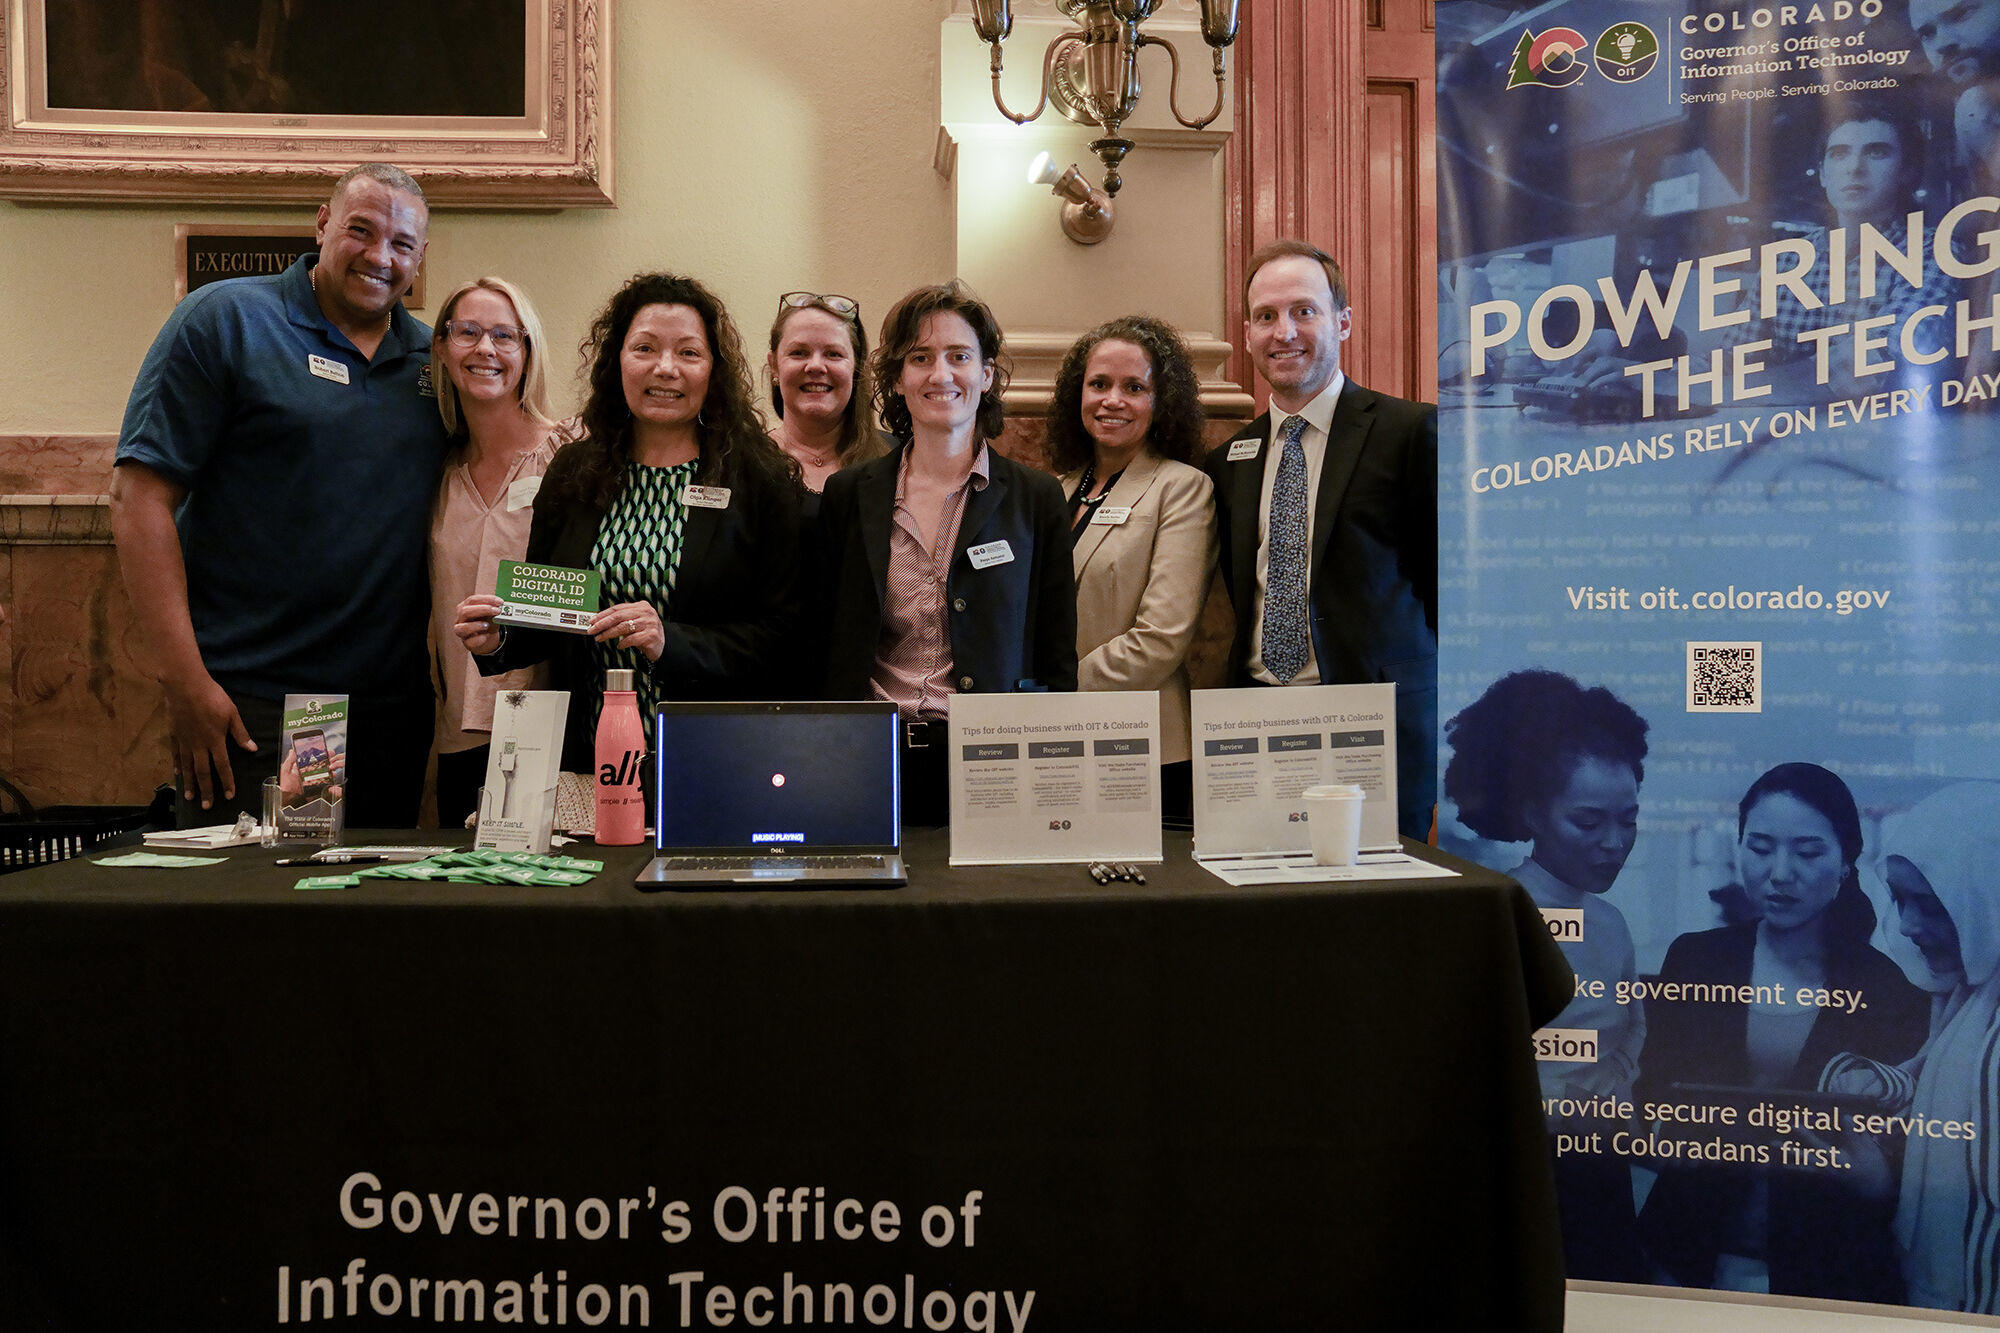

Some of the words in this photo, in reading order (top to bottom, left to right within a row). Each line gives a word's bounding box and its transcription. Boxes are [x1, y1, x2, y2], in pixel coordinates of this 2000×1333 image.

[1680, 0, 1883, 34] COLORADO
[1680, 41, 1779, 61] Governor's
[1784, 34, 1841, 53] Office
[1845, 31, 1865, 46] of
[1617, 67, 1636, 77] OIT
[1680, 59, 1792, 79] Information
[1796, 49, 1910, 70] Technology
[1680, 91, 1727, 104] Serving
[1731, 87, 1777, 101] People.
[1781, 83, 1830, 97] Serving
[1834, 76, 1899, 92] Colorado.
[195, 252, 297, 272] EXECUTIVE
[1470, 196, 2000, 377] POWERING
[1624, 340, 1772, 418] THE
[1797, 294, 2000, 388] TECH
[1471, 433, 1675, 494] COLORADANS
[1684, 418, 1760, 455] RELY
[1769, 404, 1816, 437] ON
[1828, 385, 1932, 428] EVERY
[1941, 374, 2000, 408] DAY
[513, 566, 586, 583] COLORADO
[512, 577, 566, 594] DIGITAL
[569, 584, 585, 596] ID
[510, 591, 555, 602] accepted
[558, 595, 584, 607] here!
[1566, 586, 1631, 610] Visit
[1640, 585, 1891, 615] oit.colorado.gov
[288, 712, 343, 727] myColorado
[962, 726, 982, 737] Tips
[983, 725, 996, 735] for
[997, 724, 1022, 736] doing
[1024, 723, 1061, 734] business
[1064, 722, 1083, 732] with
[1085, 722, 1101, 731] OIT
[1103, 722, 1109, 730] &
[1111, 720, 1149, 730] Colorado
[1204, 722, 1222, 732] Tips
[1223, 721, 1236, 730] for
[1237, 720, 1262, 730] doing
[1263, 718, 1300, 728] business
[1301, 716, 1321, 725] with
[1323, 715, 1338, 724] OIT
[1340, 715, 1346, 723] &
[1347, 713, 1384, 722] Colorado
[978, 748, 1003, 757] Review
[1042, 746, 1070, 755] Register
[1113, 743, 1130, 751] Visit
[1220, 743, 1244, 752] Review
[1281, 739, 1308, 748] Register
[1546, 919, 1580, 938] on
[1616, 979, 1785, 1005] government
[1796, 986, 1868, 1014] easy.
[1542, 1095, 1634, 1119] rovide
[1644, 1102, 1738, 1126] secure
[1748, 1103, 1842, 1134] digital
[1853, 1112, 1977, 1141] services
[1557, 1132, 1602, 1157] put
[1612, 1132, 1770, 1164] Coloradans
[1781, 1142, 1852, 1170] first.
[339, 1172, 692, 1243] Governor's
[713, 1186, 901, 1243] Office
[920, 1189, 983, 1248] of
[278, 1258, 650, 1327] Information
[668, 1271, 1036, 1333] Technology
